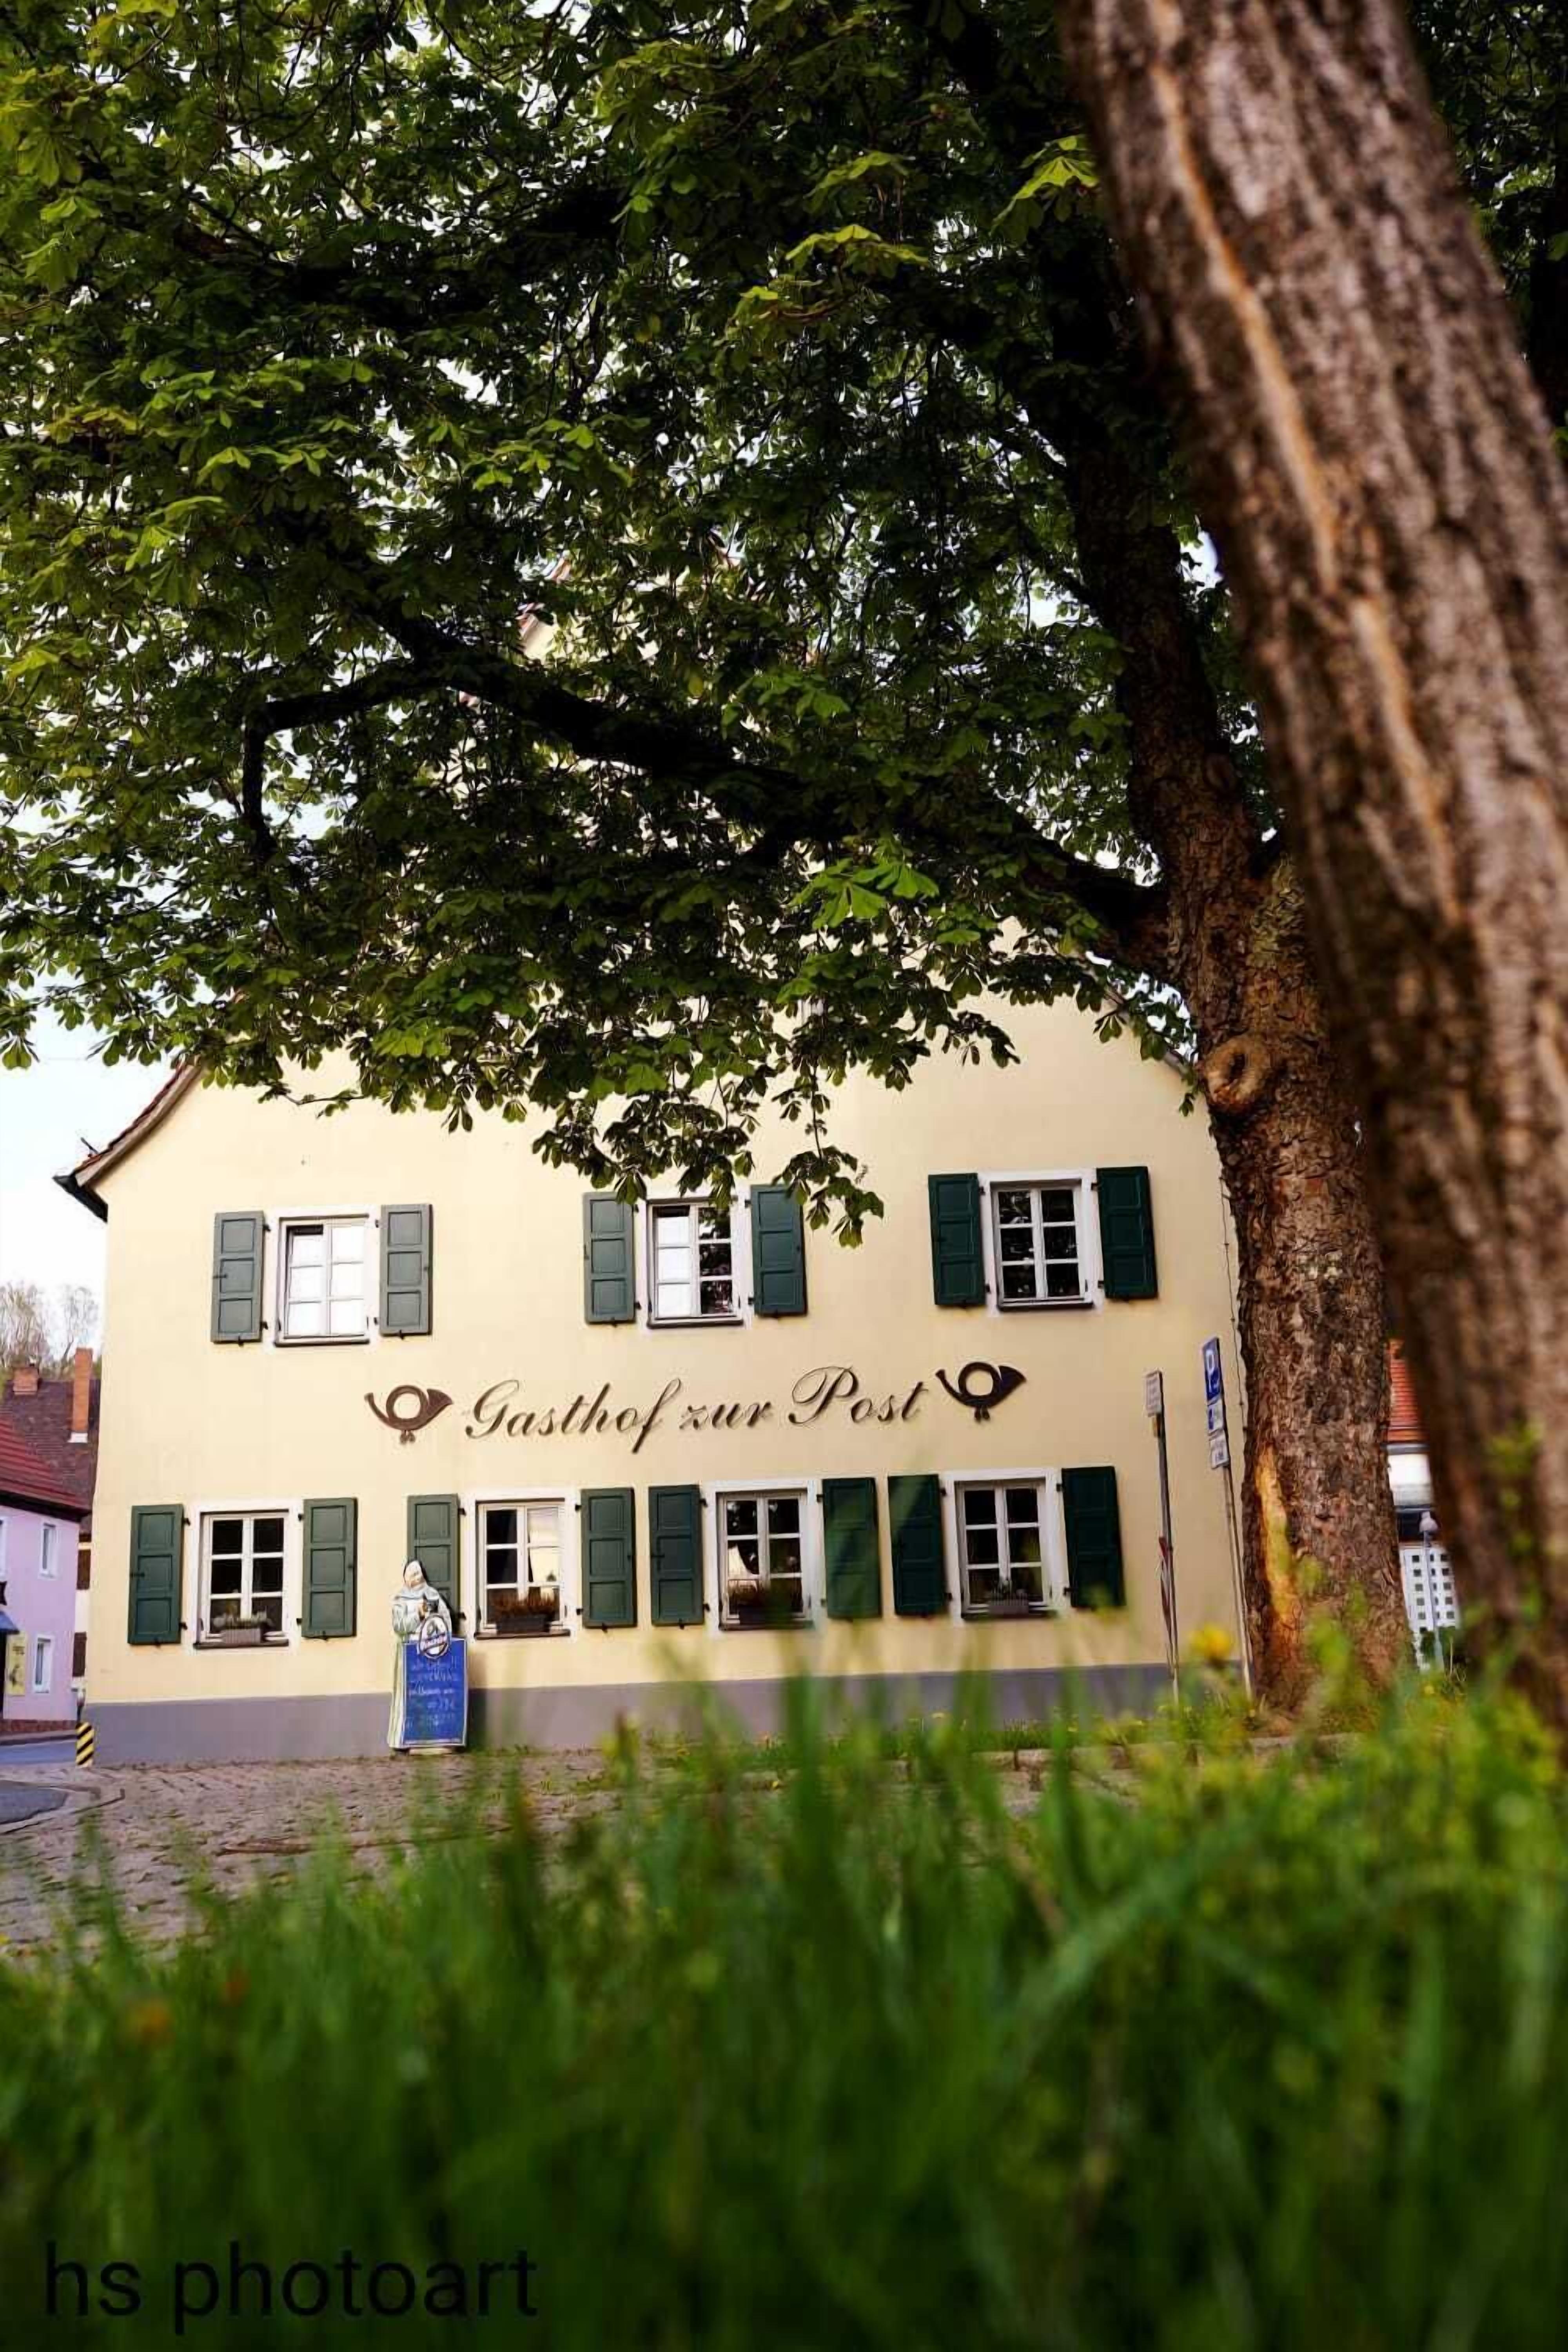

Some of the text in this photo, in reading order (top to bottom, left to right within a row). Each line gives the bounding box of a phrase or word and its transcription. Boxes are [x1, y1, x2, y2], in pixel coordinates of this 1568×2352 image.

[466, 1366, 929, 1453] Gasthof zur Post
